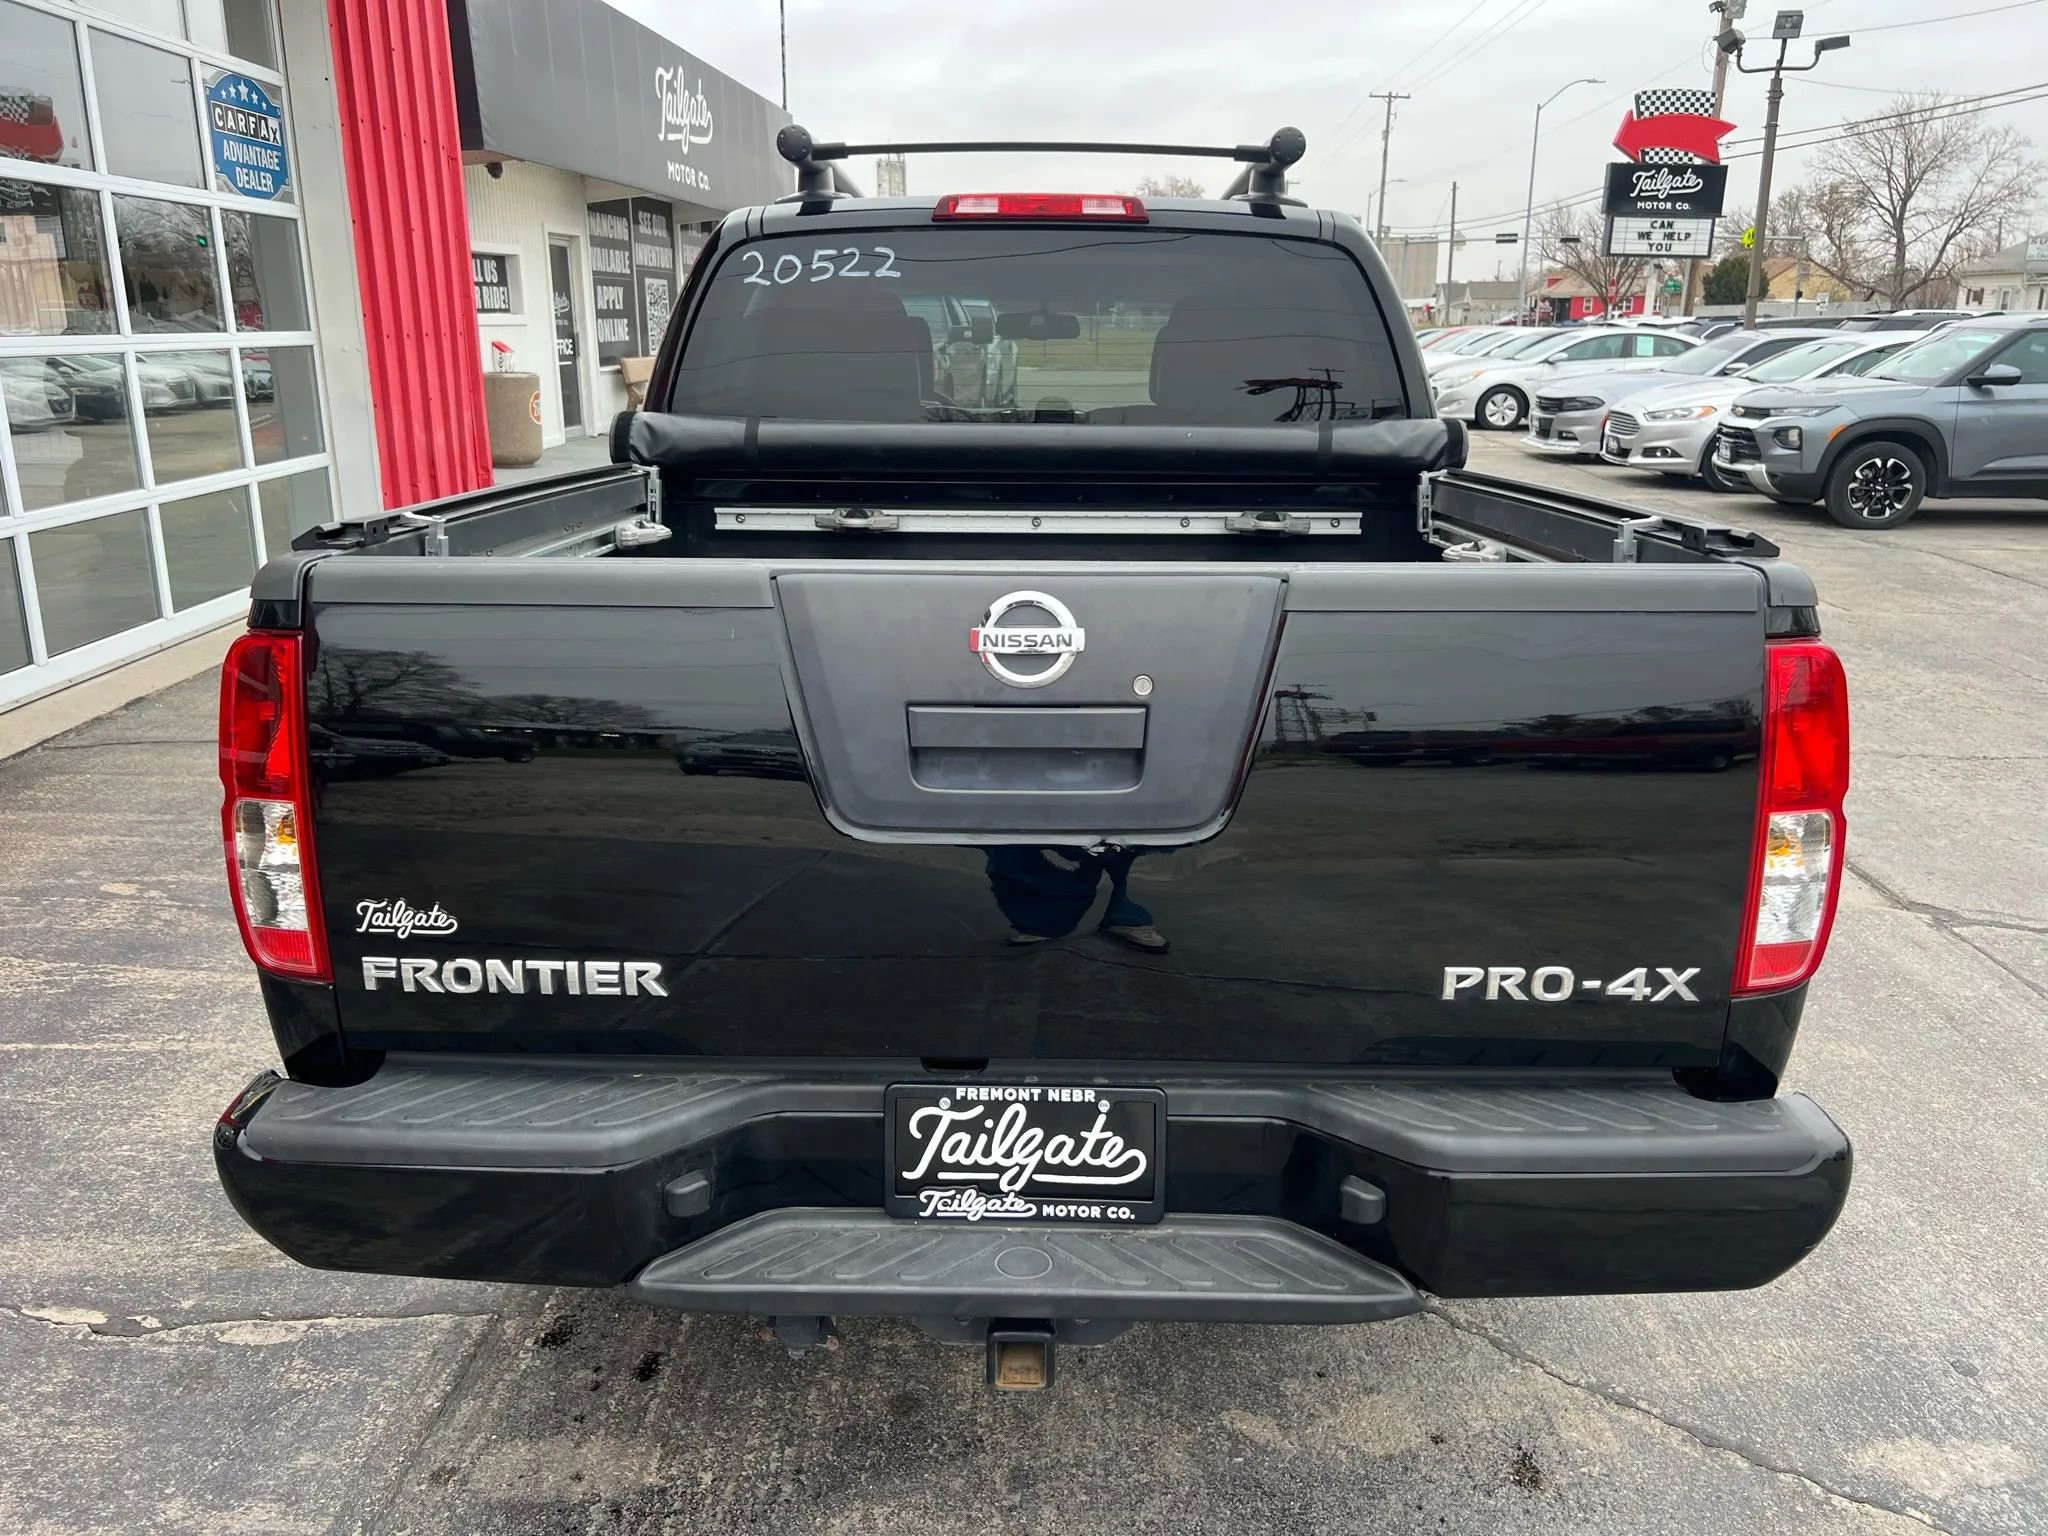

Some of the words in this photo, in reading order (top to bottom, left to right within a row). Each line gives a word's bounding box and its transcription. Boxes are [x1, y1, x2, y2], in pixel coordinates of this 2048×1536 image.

[655, 65, 713, 154] Tailgate
[214, 107, 279, 145] CARFAX
[223, 139, 280, 171] ADVANTAGE
[235, 166, 274, 193] DEALER
[667, 160, 696, 187] MOTOR
[1630, 167, 1703, 199] Tailgate
[1637, 202, 1672, 210] MOTOR
[589, 211, 629, 241] NANCING
[639, 211, 652, 235] SEE
[1637, 231, 1653, 240] WE
[1663, 232, 1691, 241] HELP
[1651, 220, 1674, 230] CAN
[591, 247, 631, 274] VAILABLE
[635, 243, 673, 269] INVENTORY
[1648, 243, 1672, 252] YOU
[484, 259, 498, 284] US
[742, 247, 901, 286] 20522
[482, 286, 509, 309] RIDE!
[597, 285, 624, 310] APPLY
[598, 318, 630, 342] ONLINE
[983, 633, 1073, 648] NISSAN
[355, 897, 458, 939] Tailgate
[361, 956, 669, 997] FRONTIER
[1441, 966, 1701, 1002] PRO-4X
[955, 1087, 1042, 1102] FREMONT
[1048, 1088, 1096, 1103] NEBR
[901, 1102, 1147, 1193] Tailgate
[919, 1188, 1037, 1222] Tailgate
[1042, 1204, 1101, 1219] MOTOR
[1108, 1206, 1135, 1220] CO.
